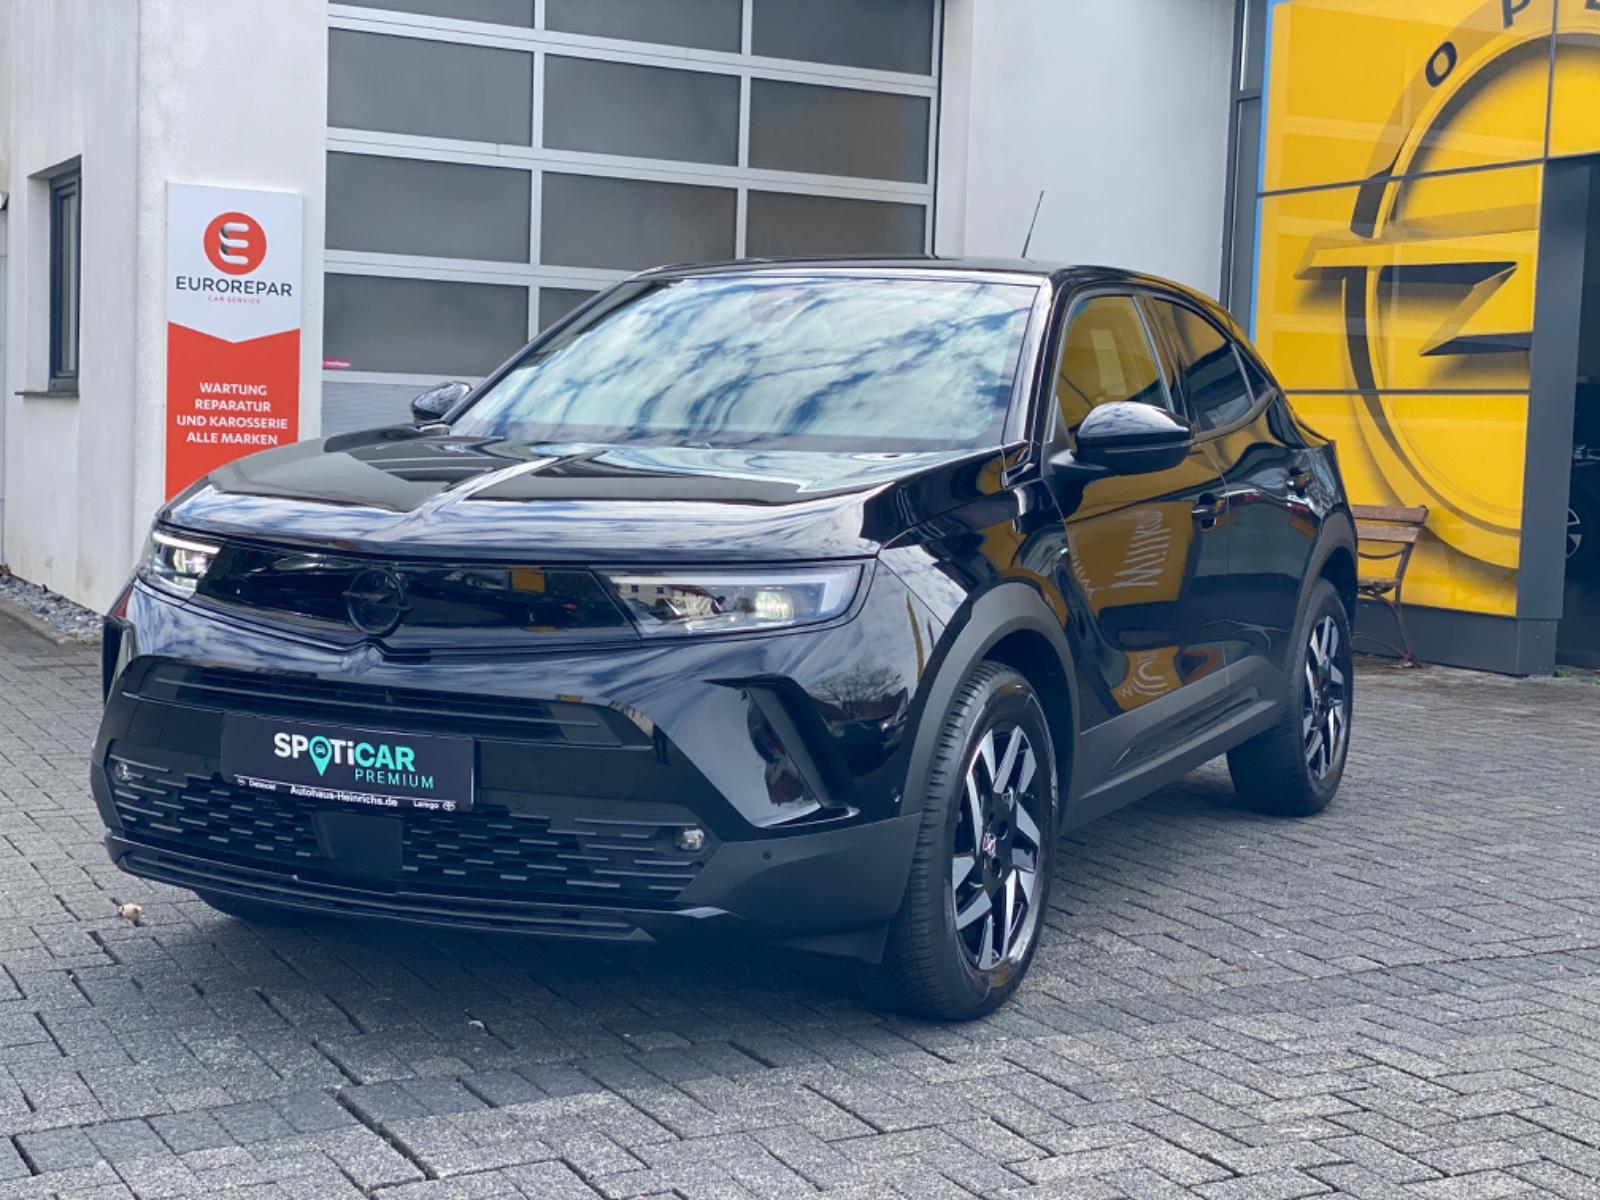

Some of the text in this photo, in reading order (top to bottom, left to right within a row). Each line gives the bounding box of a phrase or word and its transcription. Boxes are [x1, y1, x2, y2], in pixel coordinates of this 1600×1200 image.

[175, 275, 293, 297] EUROREPAR
[227, 296, 261, 305] SERVICE
[199, 382, 267, 396] WARTUNG
[195, 398, 271, 412] REPARATUR
[177, 414, 288, 429] UND KAROSSERIE
[186, 431, 278, 445] ALLE MARKEN
[355, 768, 434, 789] PREMIUM
[290, 785, 398, 807] Autohaus-Heinrichs.de
